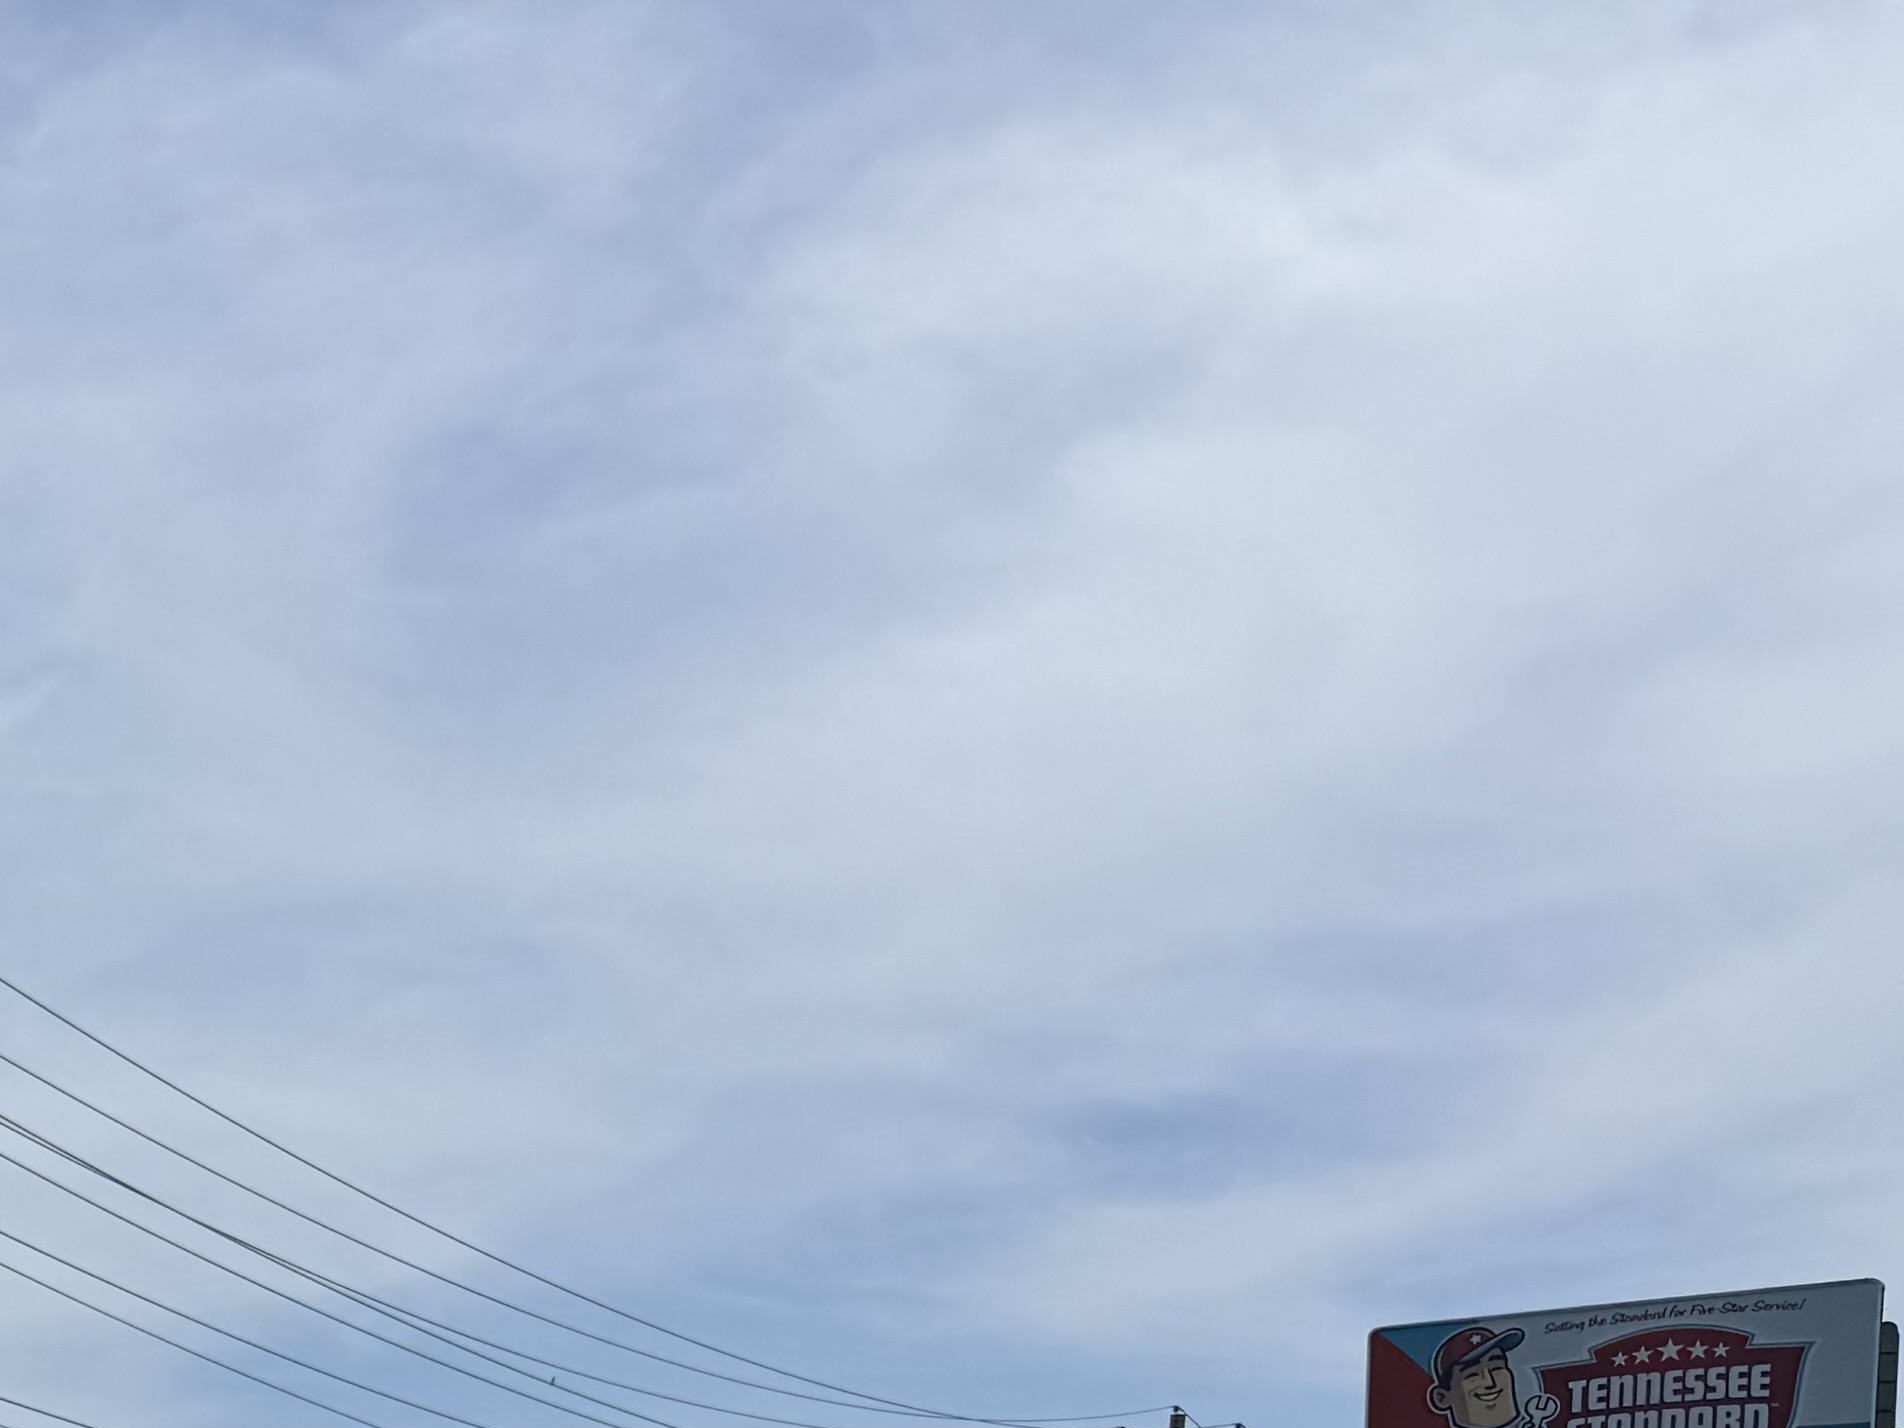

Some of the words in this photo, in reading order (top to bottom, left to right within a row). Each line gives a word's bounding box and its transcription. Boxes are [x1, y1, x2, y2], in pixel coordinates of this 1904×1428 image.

[1589, 1311, 1607, 1327] the
[1610, 1307, 1666, 1325] Standard
[1669, 1305, 1687, 1318] for
[1568, 1364, 1772, 1413] TENNESSEE
